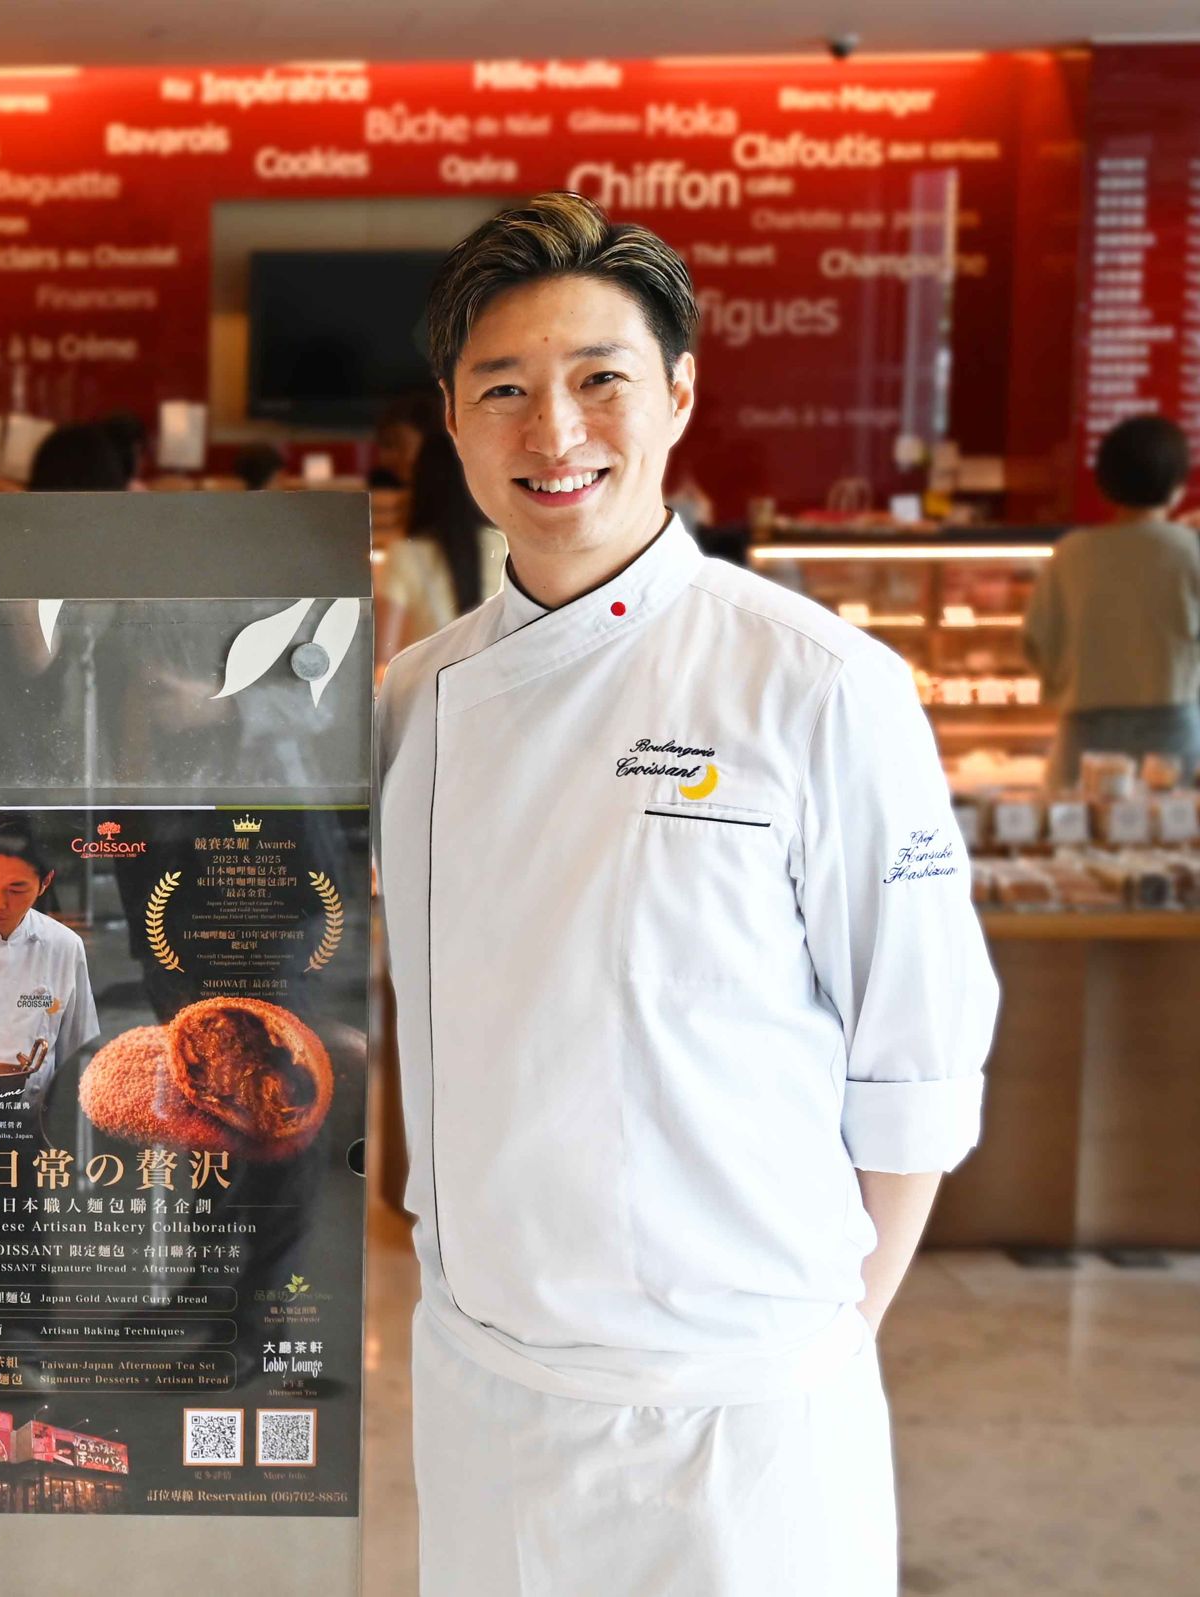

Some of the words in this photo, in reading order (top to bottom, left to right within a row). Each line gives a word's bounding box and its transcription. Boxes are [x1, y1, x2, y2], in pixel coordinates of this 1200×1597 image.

[366, 102, 470, 142] Bûche
[645, 102, 737, 136] Moka
[106, 122, 229, 154] Bavarois
[733, 130, 883, 168] Clafoutis
[256, 146, 369, 179] Cookies
[440, 153, 517, 184] Opéra
[568, 161, 739, 209] Chiffon
[630, 738, 716, 758] Boulangerie
[616, 757, 702, 778] Croissant
[71, 838, 147, 853] Croissant
[256, 840, 297, 850] Awards
[212, 855, 239, 864] 2023
[255, 855, 282, 864] 2025
[17, 1000, 53, 1008] CROISSANT
[32, 1220, 87, 1233] Artisan
[93, 1220, 147, 1235] Bakery
[152, 1221, 257, 1234] Collaboration
[69, 1244, 126, 1258] 限定麵包
[40, 1264, 93, 1274] Signature
[96, 1264, 128, 1273] Bread
[142, 1264, 197, 1274] Afternoon
[201, 1265, 220, 1274] Tea
[223, 1265, 241, 1274] Set
[40, 1294, 71, 1304] Japan
[75, 1294, 100, 1303] Gold
[104, 1294, 138, 1304] Award
[142, 1294, 171, 1305] Curry
[177, 1295, 208, 1304] Bread
[40, 1326, 79, 1335] Artisan
[84, 1326, 120, 1337] Baking
[124, 1327, 186, 1337] Techniques
[263, 1341, 324, 1354] 大廳茶軒
[40, 1360, 114, 1371] Taiwan-Japan
[118, 1361, 172, 1370] Afternoon
[176, 1361, 195, 1370] Tea
[199, 1361, 216, 1370] Set
[263, 1356, 289, 1379] Lobby
[291, 1356, 323, 1378] Lounge
[40, 1375, 91, 1385] Signature
[95, 1375, 140, 1385] Desserts
[155, 1375, 194, 1384] Artisan
[198, 1376, 229, 1385] Bread
[198, 1490, 267, 1502] Reservation
